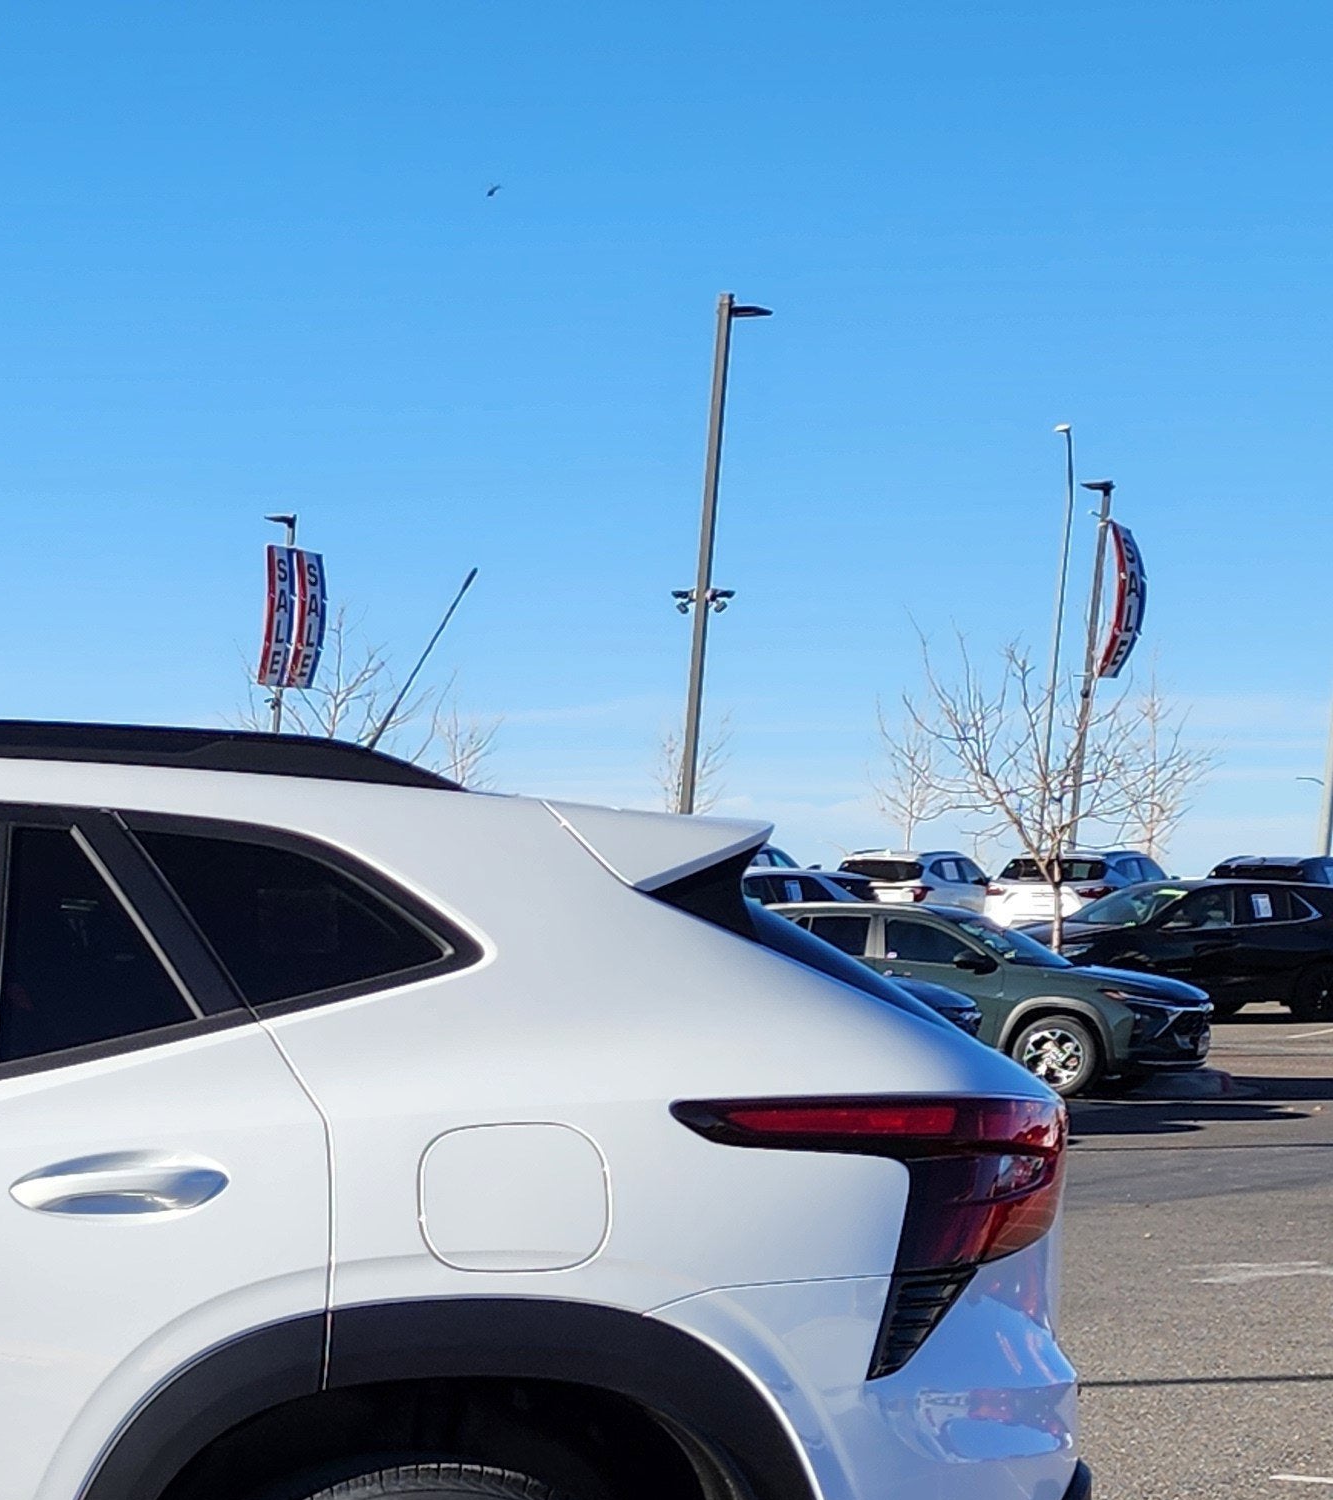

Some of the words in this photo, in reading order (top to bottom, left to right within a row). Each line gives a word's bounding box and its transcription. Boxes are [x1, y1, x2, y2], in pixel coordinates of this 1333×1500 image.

[268, 557, 288, 675] SALE
[297, 562, 319, 678] SALE
[1110, 536, 1139, 667] SALE
